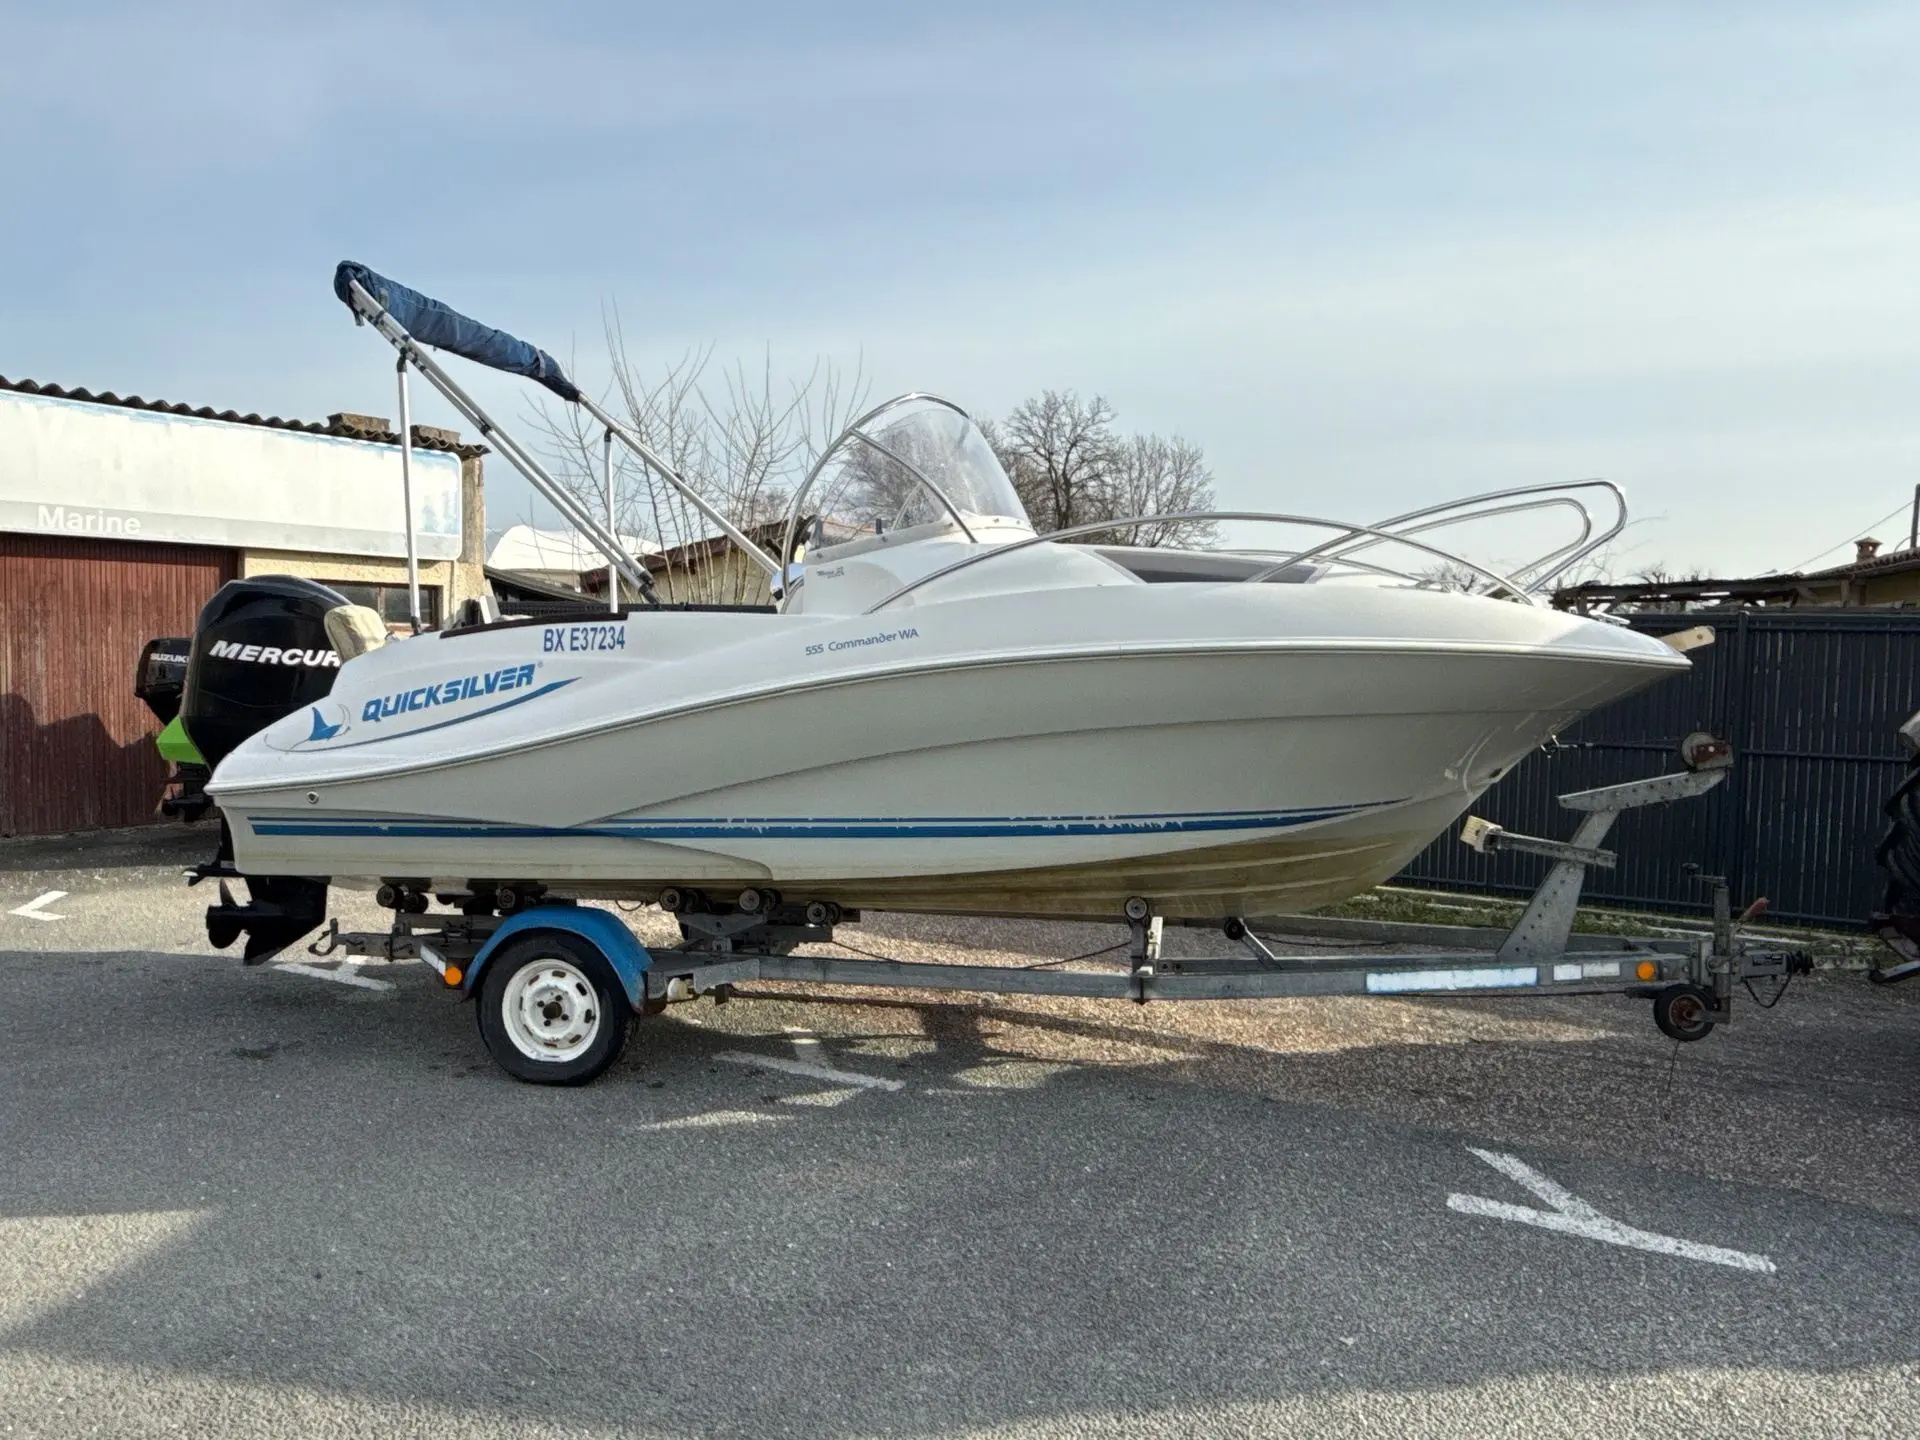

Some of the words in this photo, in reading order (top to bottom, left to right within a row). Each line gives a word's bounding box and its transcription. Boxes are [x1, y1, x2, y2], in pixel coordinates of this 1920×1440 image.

[38, 505, 141, 534] Marine
[543, 628, 565, 652] BX
[570, 627, 625, 651] E37234
[828, 632, 897, 651] Commander
[898, 628, 919, 640] WA
[209, 640, 341, 668] MERCUR
[361, 664, 536, 722] QUICKSILVER
